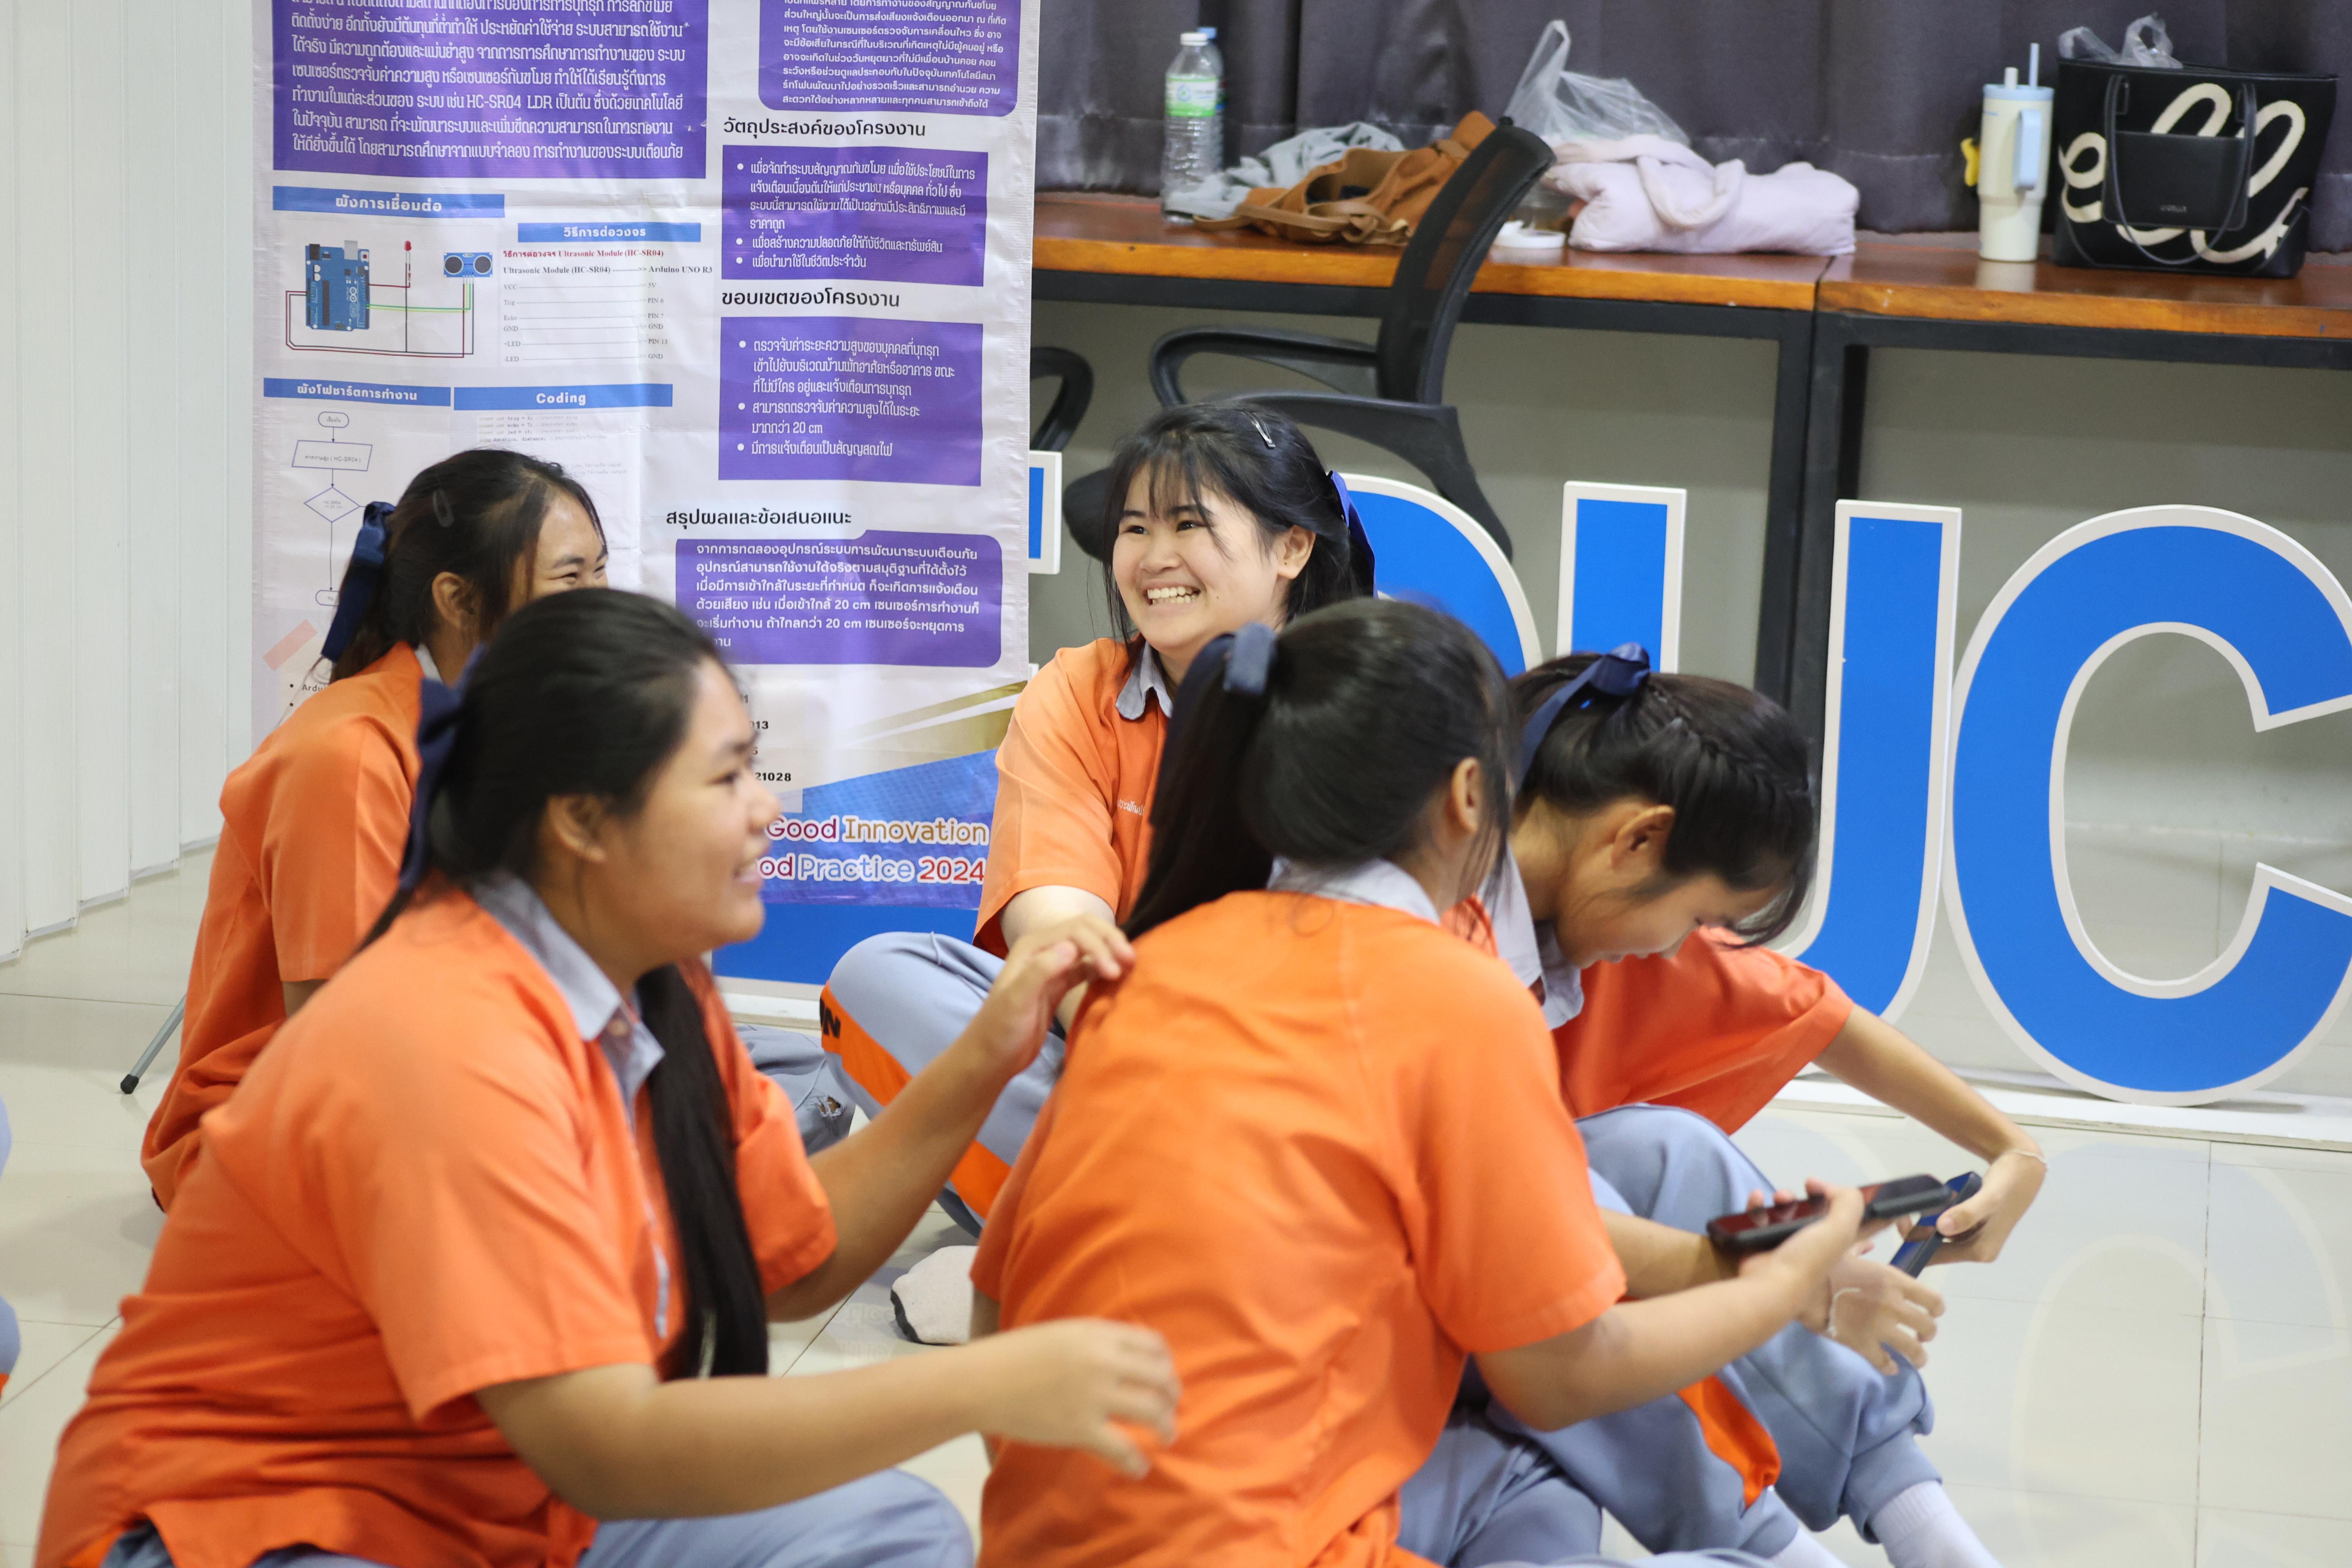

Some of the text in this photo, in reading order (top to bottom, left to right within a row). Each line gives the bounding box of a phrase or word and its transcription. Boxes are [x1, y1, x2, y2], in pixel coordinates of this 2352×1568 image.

[291, 8, 343, 31] ติดตั้งง่าย
[481, 18, 573, 36] ประหยัดค่าใช้จ่าย
[576, 20, 683, 38] ระบบสามารถใช้งาน
[987, 12, 1007, 25] ที่เกิด
[784, 25, 799, 36] เหตุ
[292, 34, 326, 54] ได้จริง
[329, 38, 474, 64] มีความถูกต้องและแม่นยำสูง
[658, 48, 686, 62] ระบบ
[987, 44, 1004, 53] หรือ
[292, 62, 666, 91] เซนเซอร์ตรวจจับค่าความสูง หรือเซนเซอร์กันขโมย ทำให้ได้เรียนรู้ถึงการ
[292, 85, 684, 111] ทำงานในแต่ละส่วนของ ระบบ เช่น HC-SR04 LDR เป็นต้น ซึ่งด้วยเทคโนโลยี
[979, 87, 1000, 95] ความ
[292, 108, 343, 132] ในปัจจุบัน
[345, 118, 388, 131] สามารถ
[723, 116, 926, 139] วัตถุประสงค์ของโครงงาน
[292, 132, 684, 159] ให้ดียิ่งขึ้นได้ โดยสามารถศึกษาจากแบบจำลอง การทำงานของระบบเตือนภัย
[751, 157, 975, 180] เพื่อจัดทำระบบสัญญาณกันขโมย เพื่อใช้ประโยชน์ในการ
[750, 177, 962, 199] แจ้งเตือนเบื้องต้นให้แก่ประชาชน หรือบุคคล ทั่วไป ซึ่ง
[336, 194, 443, 212] ผังการเชื่อมต่อ
[563, 225, 646, 238] วิธีการต่อวงจร
[750, 218, 785, 233] ราคาถูก
[559, 249, 595, 258] Ultrasonic
[624, 249, 664, 258] (HC-SR04)
[753, 251, 867, 267] เพื่อนำมาใช้ในชีวิตประจำวัน
[571, 266, 611, 275] (HC-SR04)
[722, 288, 900, 307] ขอบเขตของโครงงาน
[753, 337, 939, 361] ตรวจจับค่าระยะความสูงของบุคคลที่บุกรุก
[753, 357, 955, 378] เข้าไปยังบริเวณบ้านพักอาศัยหรืออาคาร ขณะ
[296, 383, 418, 401] ผังโฟชาร์ตการทำงาน
[753, 376, 911, 399] ที่ไม่มีใคร อยู่และแจ้งเตือนการบุกรุก
[536, 392, 587, 406] Coding
[753, 399, 920, 418] สามารถตรวจจับค่าความสูงได้ในระยะ
[751, 419, 823, 434] มากกว่า 20 cm
[666, 507, 851, 530] สรุปผลและข้อเสนอแนะ
[696, 543, 978, 560] จากการทดลองอุปกรณ์ระบบการพัฒนาระบบเตือนภัย
[869, 579, 978, 596] ก็จะเกิดการแจ้งเตือน
[696, 594, 980, 614] ด้วยเสียง เช่น เมื่อเข้าใกล้ 20 cm เซนเซอร์การทำงานก็
[766, 616, 822, 628] ถ้าไกลกว่า
[826, 618, 840, 628] 20
[844, 620, 862, 628] cm
[865, 618, 965, 635] เซนเซอร์จะหยุดการ
[766, 819, 987, 842] Good Innovation
[800, 857, 912, 879] Practice
[920, 859, 984, 882] 2024
